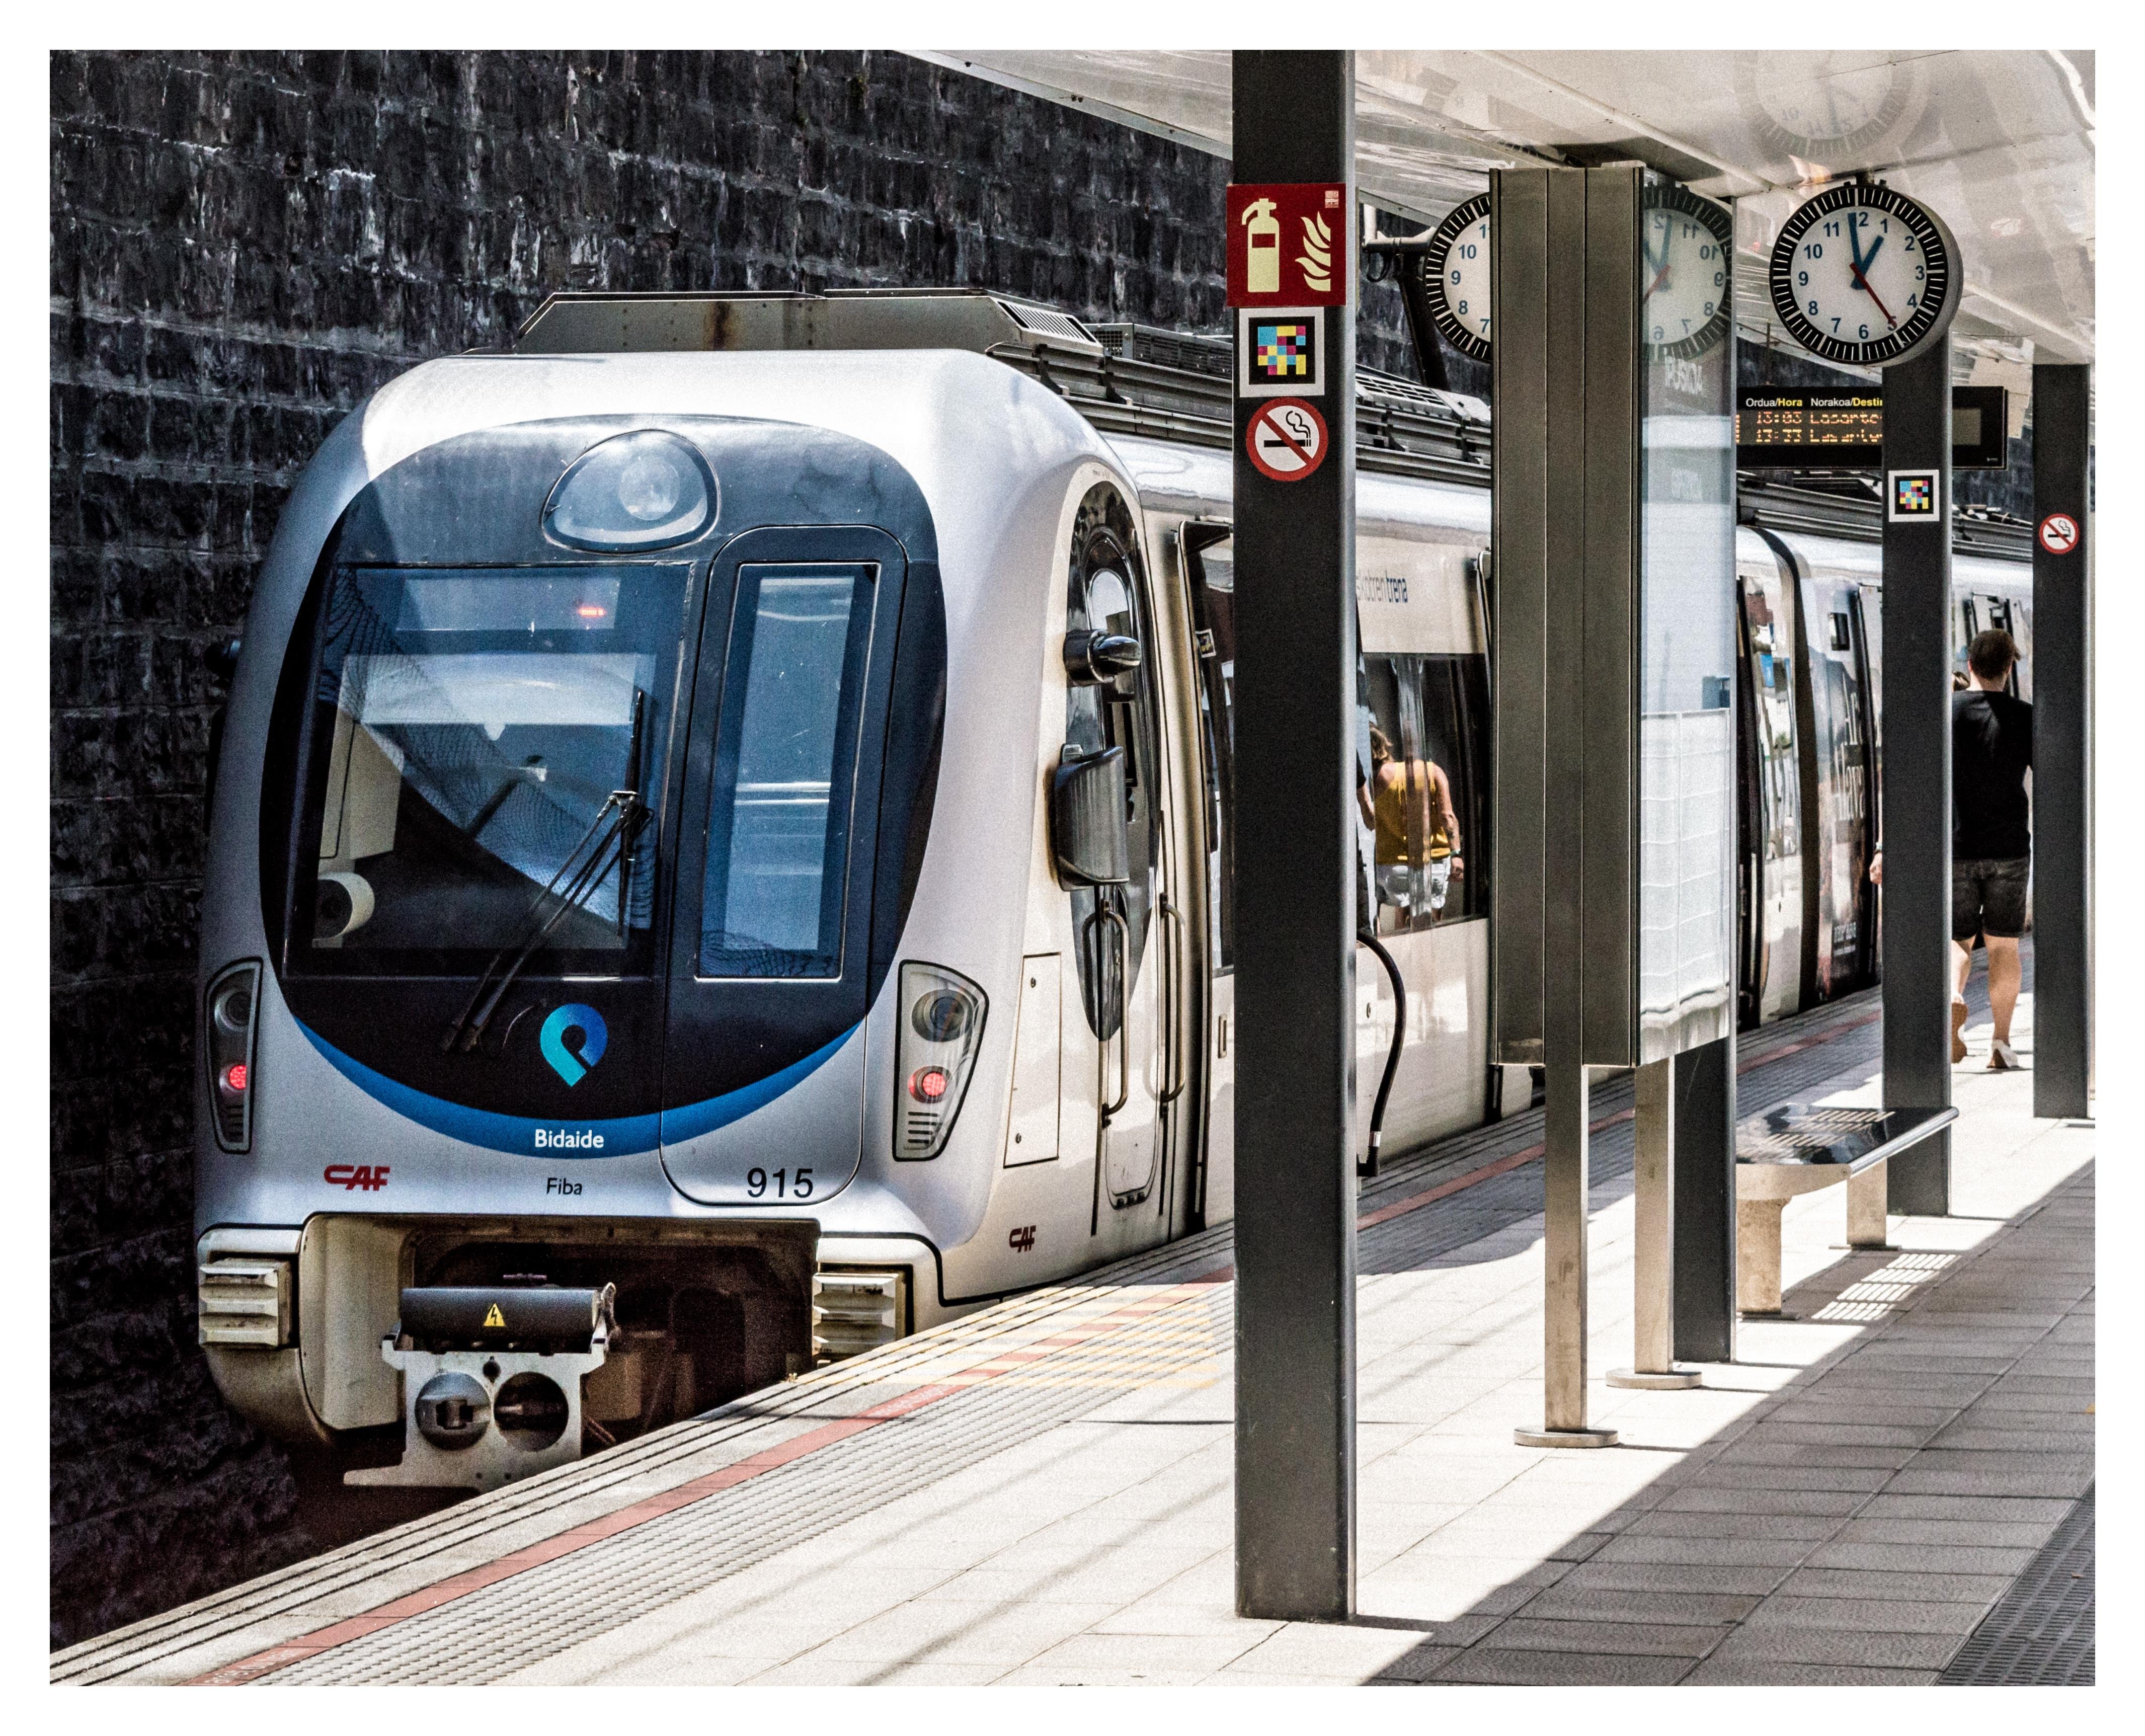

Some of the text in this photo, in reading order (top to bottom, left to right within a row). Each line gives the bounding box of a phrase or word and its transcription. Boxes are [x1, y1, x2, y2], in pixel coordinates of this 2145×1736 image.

[1479, 224, 1490, 239] 1
[1823, 222, 1839, 237] 11
[1880, 218, 1887, 233] 1
[1905, 236, 1915, 251] 2
[1459, 245, 1476, 259] 10
[1804, 244, 1822, 259] 10
[1451, 270, 1461, 285] 9
[1798, 271, 1808, 286] 9
[1916, 265, 1925, 280] 3
[1458, 300, 1468, 315] 8
[1808, 301, 1818, 315] 8
[1907, 293, 1918, 308] 4
[1480, 319, 1490, 333] 7
[1831, 318, 1841, 333] 7
[1859, 325, 1868, 339] 6
[1746, 398, 1802, 407] Ordua/Hora
[1810, 412, 1882, 424] Lasarte
[1385, 569, 1408, 603] trena
[535, 1129, 604, 1149] Bidaide
[324, 1165, 390, 1191] CAF
[747, 1167, 813, 1198] 915
[546, 1177, 583, 1195] Fiba
[1009, 1225, 1036, 1252] CAF
